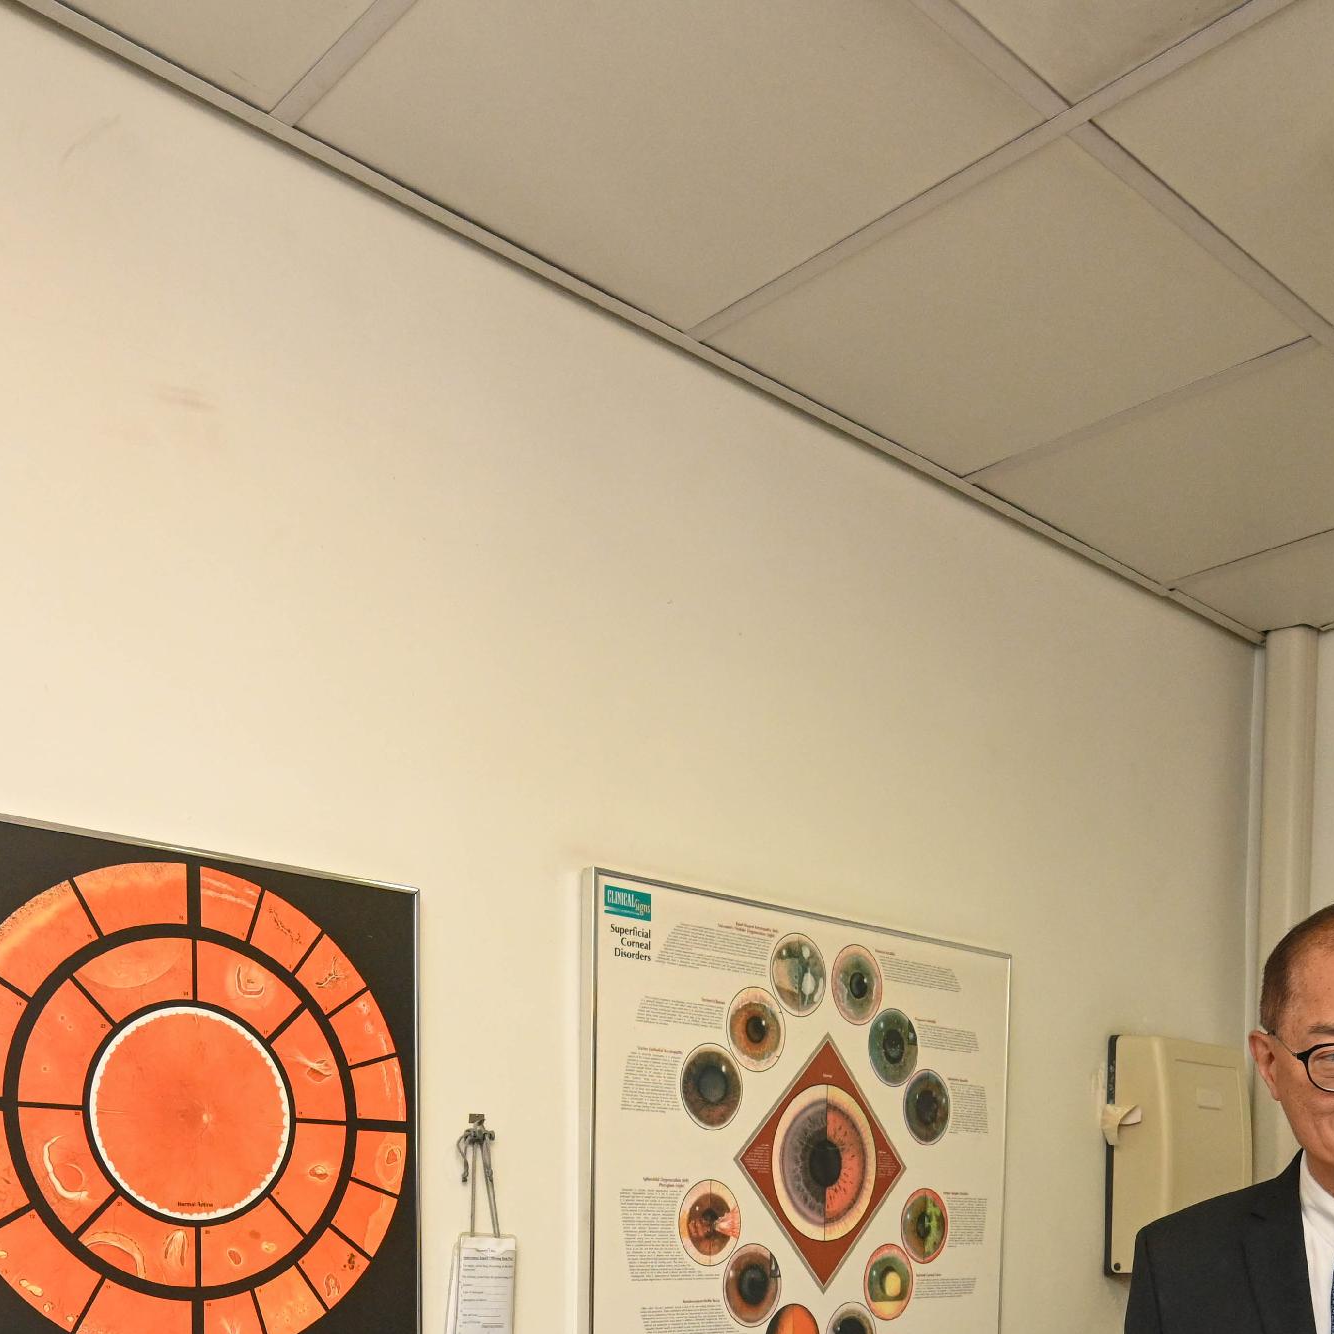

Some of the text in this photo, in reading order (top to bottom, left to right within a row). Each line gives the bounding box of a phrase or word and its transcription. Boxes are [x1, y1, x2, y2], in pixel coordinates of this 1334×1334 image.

[607, 889, 635, 908] CLINICAL
[610, 923, 651, 939] Superficial
[620, 937, 651, 951] Corneal
[614, 947, 652, 962] Disorders
